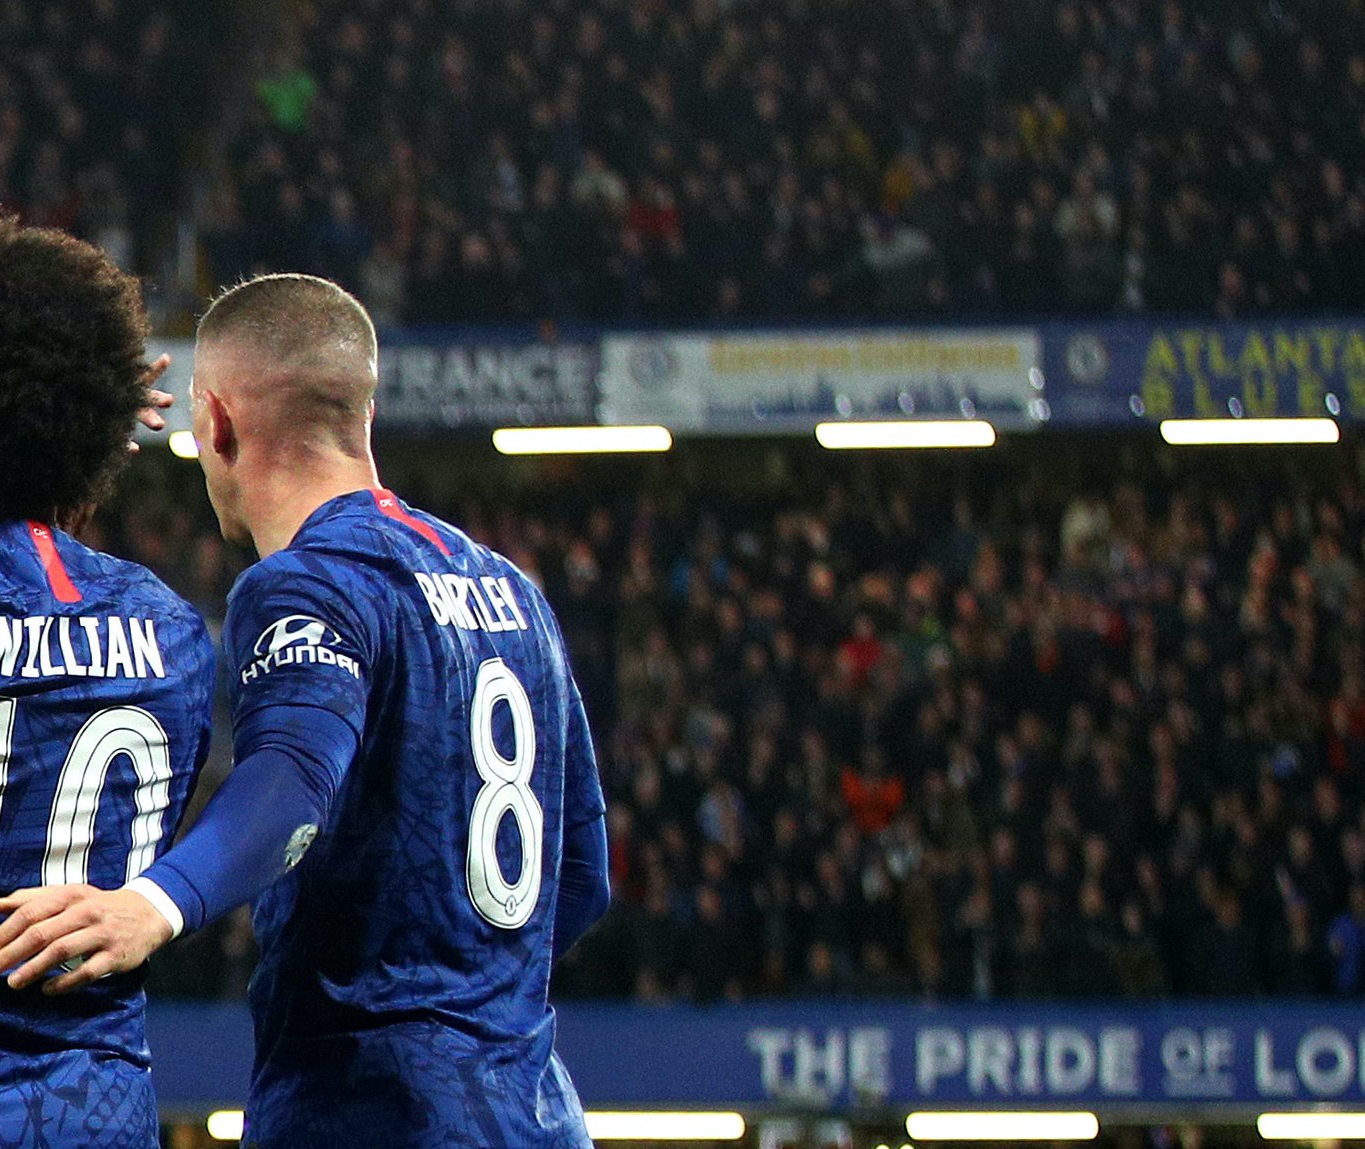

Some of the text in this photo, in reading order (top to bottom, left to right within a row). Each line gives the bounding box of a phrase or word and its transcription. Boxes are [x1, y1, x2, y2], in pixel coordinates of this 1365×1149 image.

[241, 645, 360, 685] HYUNDAI
[466, 656, 543, 930] 8
[749, 1027, 1365, 1096] THE PRIDE OF LO
